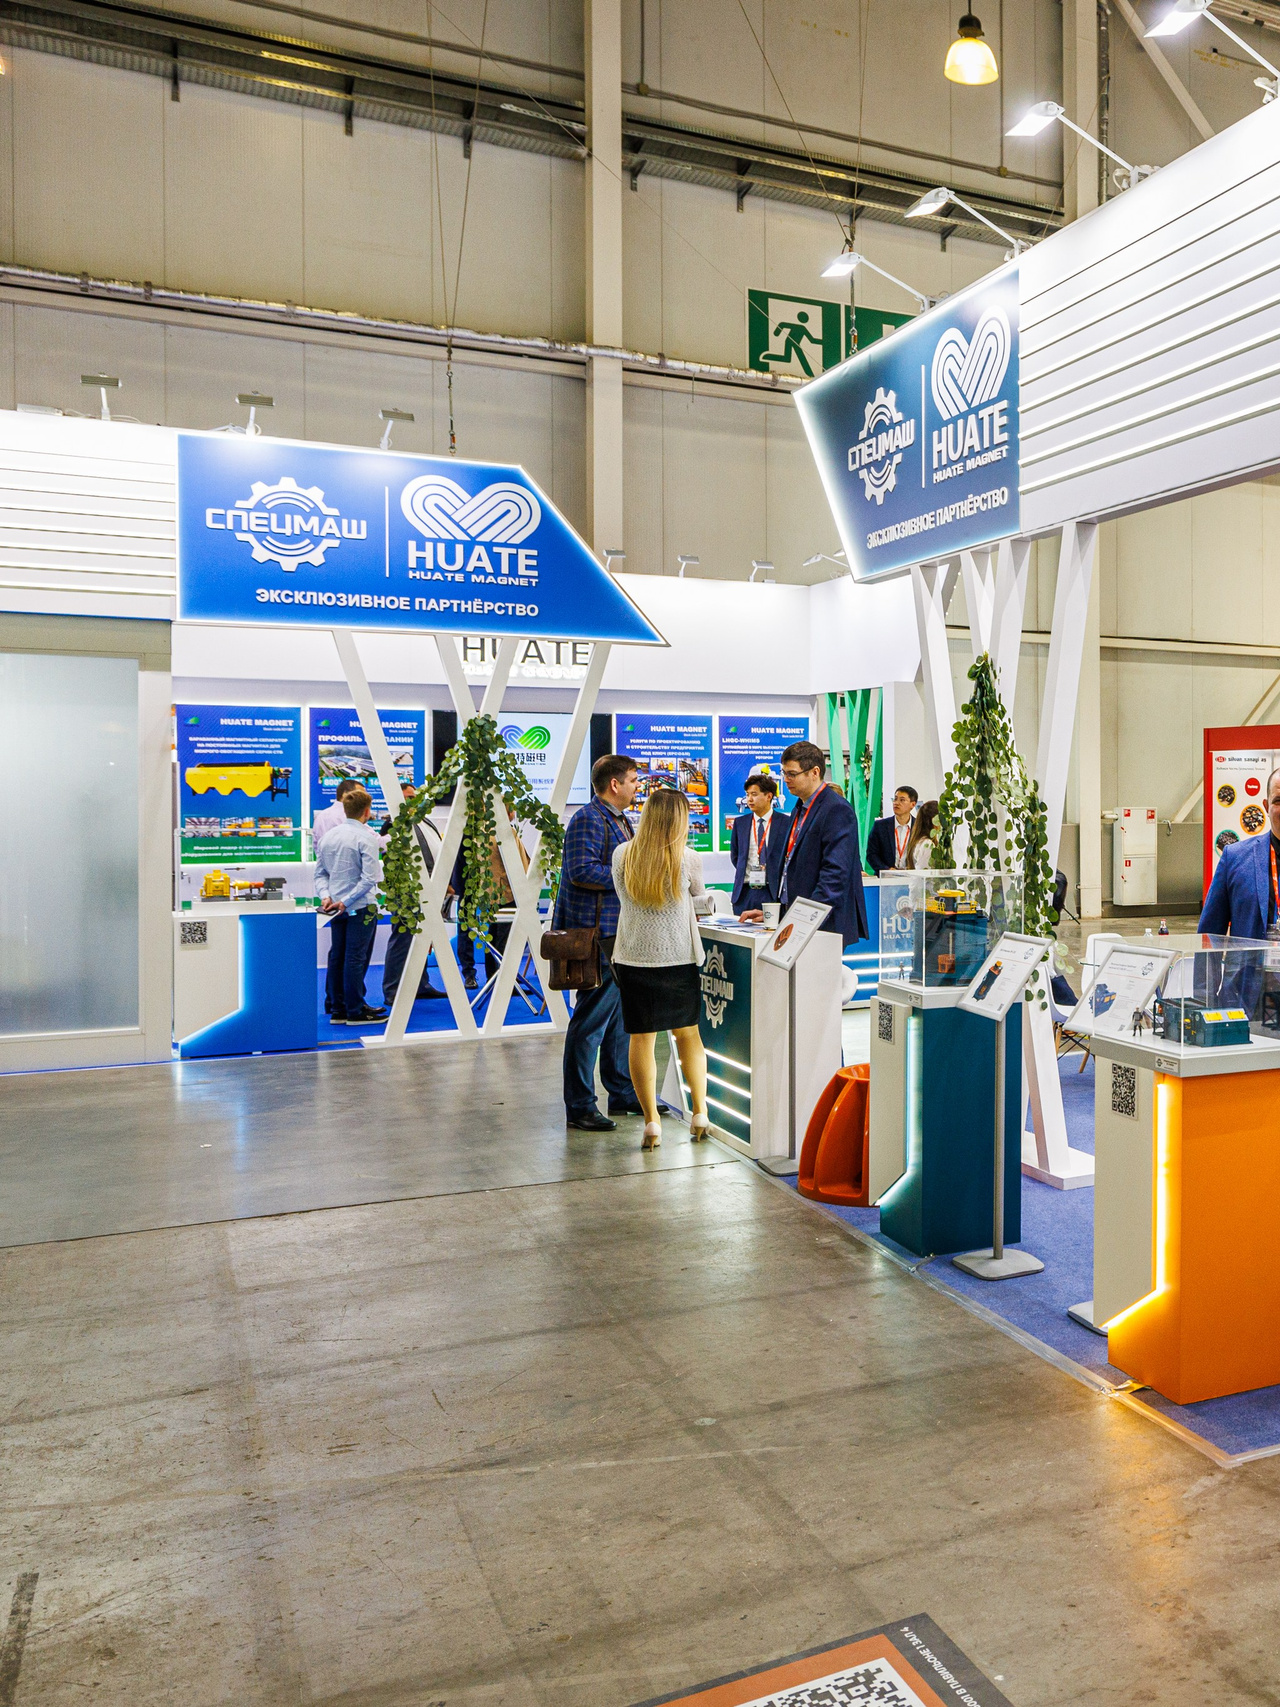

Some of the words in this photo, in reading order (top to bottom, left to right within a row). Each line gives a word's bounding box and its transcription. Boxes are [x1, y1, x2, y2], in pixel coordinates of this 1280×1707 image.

[848, 418, 915, 471] СПЕЦМАШ
[932, 400, 1008, 469] HUATE
[933, 462, 964, 483] HUATE
[966, 445, 1008, 471] MAGNET
[206, 507, 367, 540] СПЕЦМАШ
[867, 511, 935, 550] ЭКСКЛЮЗИВНОЕ
[936, 486, 1008, 526] ПАРТНЁРСТВО
[408, 541, 539, 576] HUATE
[409, 571, 465, 583] HUATE
[471, 574, 539, 587] MAGNET
[256, 588, 410, 610] ЭКСКЛЮЗИВНОЕ
[415, 594, 539, 617] ПАРТНЁРСТВО
[220, 718, 253, 726] HUATE
[381, 721, 418, 729] MAGNET
[699, 974, 733, 1000] ПЕЦМАШ
[904, 1632, 922, 1646] ЗАЛ
[919, 1648, 961, 1689] ПАВИЛЬОНЕ
